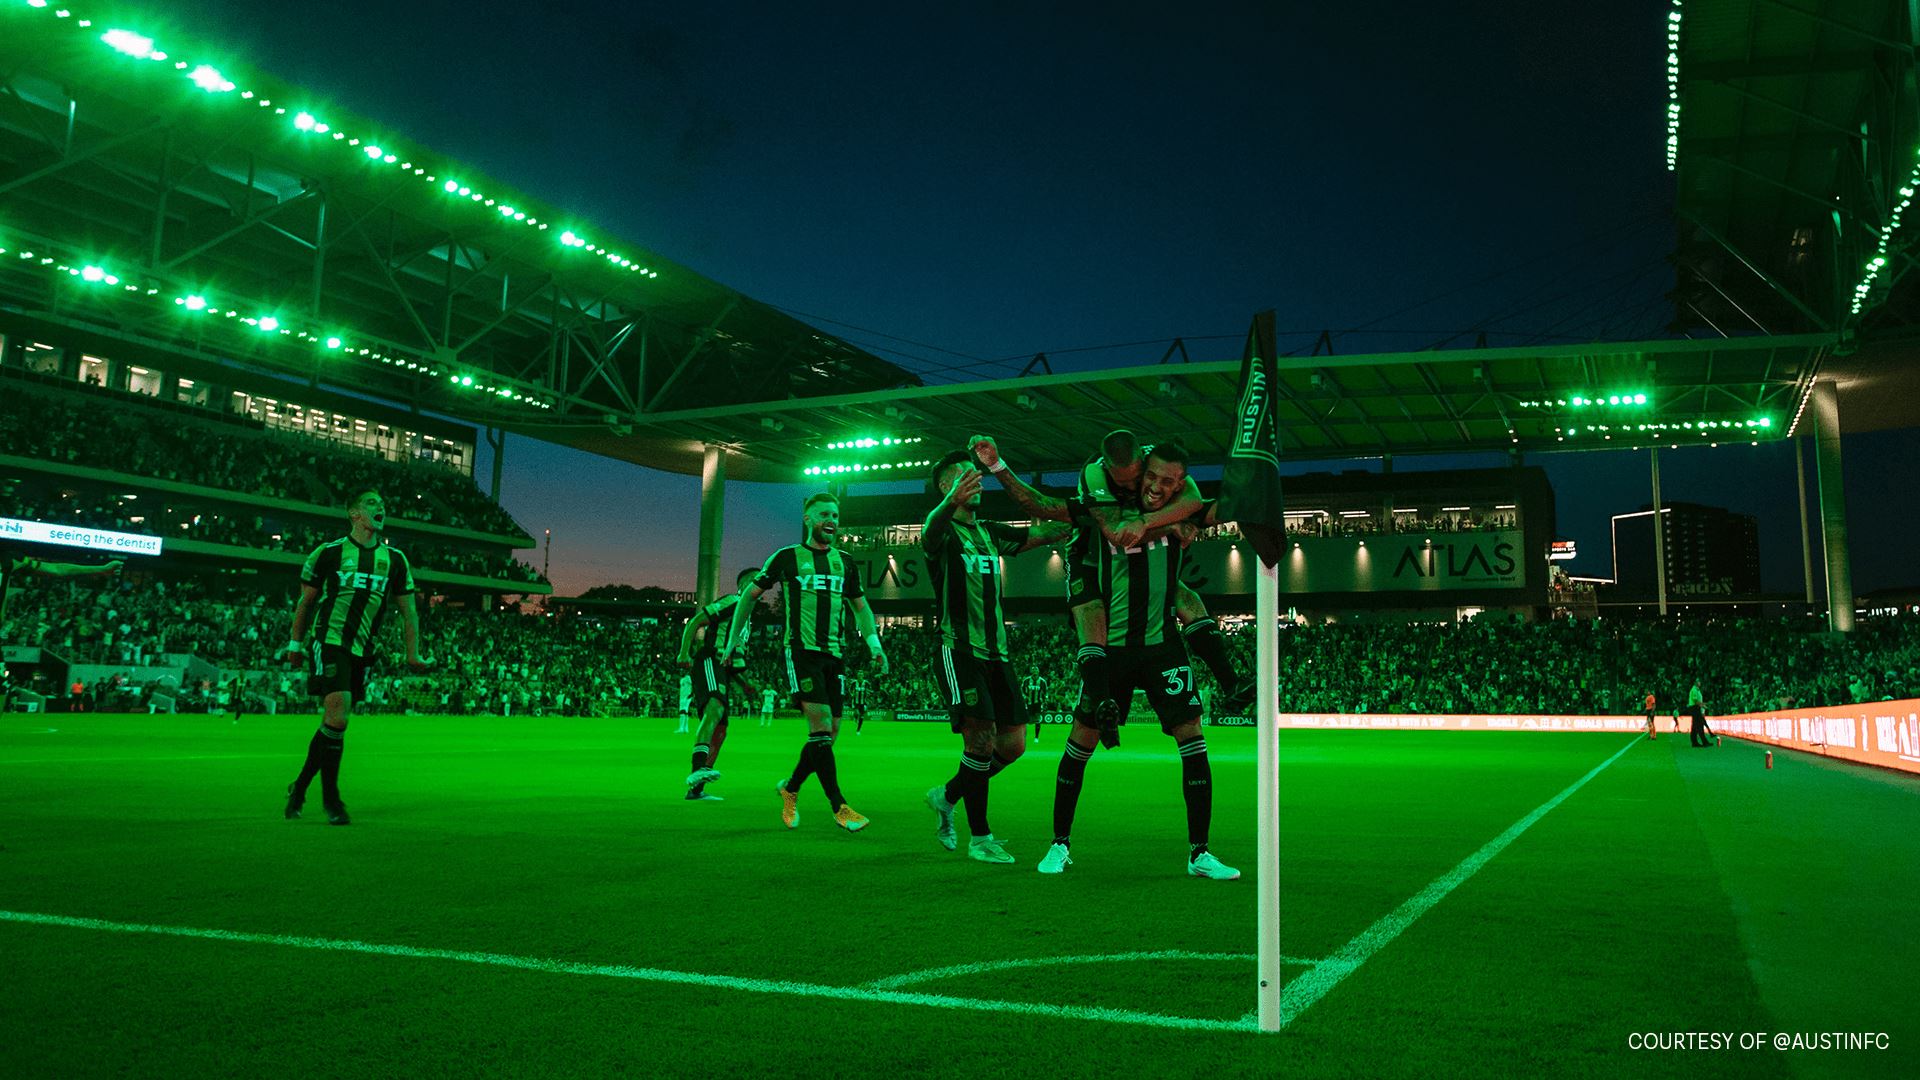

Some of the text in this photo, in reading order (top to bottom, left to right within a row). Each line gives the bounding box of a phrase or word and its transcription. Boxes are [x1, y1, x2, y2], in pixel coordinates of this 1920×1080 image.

[50, 529, 156, 550] seeing the dentist
[960, 553, 1000, 575] YET
[1393, 543, 1516, 577] ATLAS
[336, 571, 389, 592] YETI
[795, 574, 844, 593] YETI
[1162, 665, 1193, 695] 37
